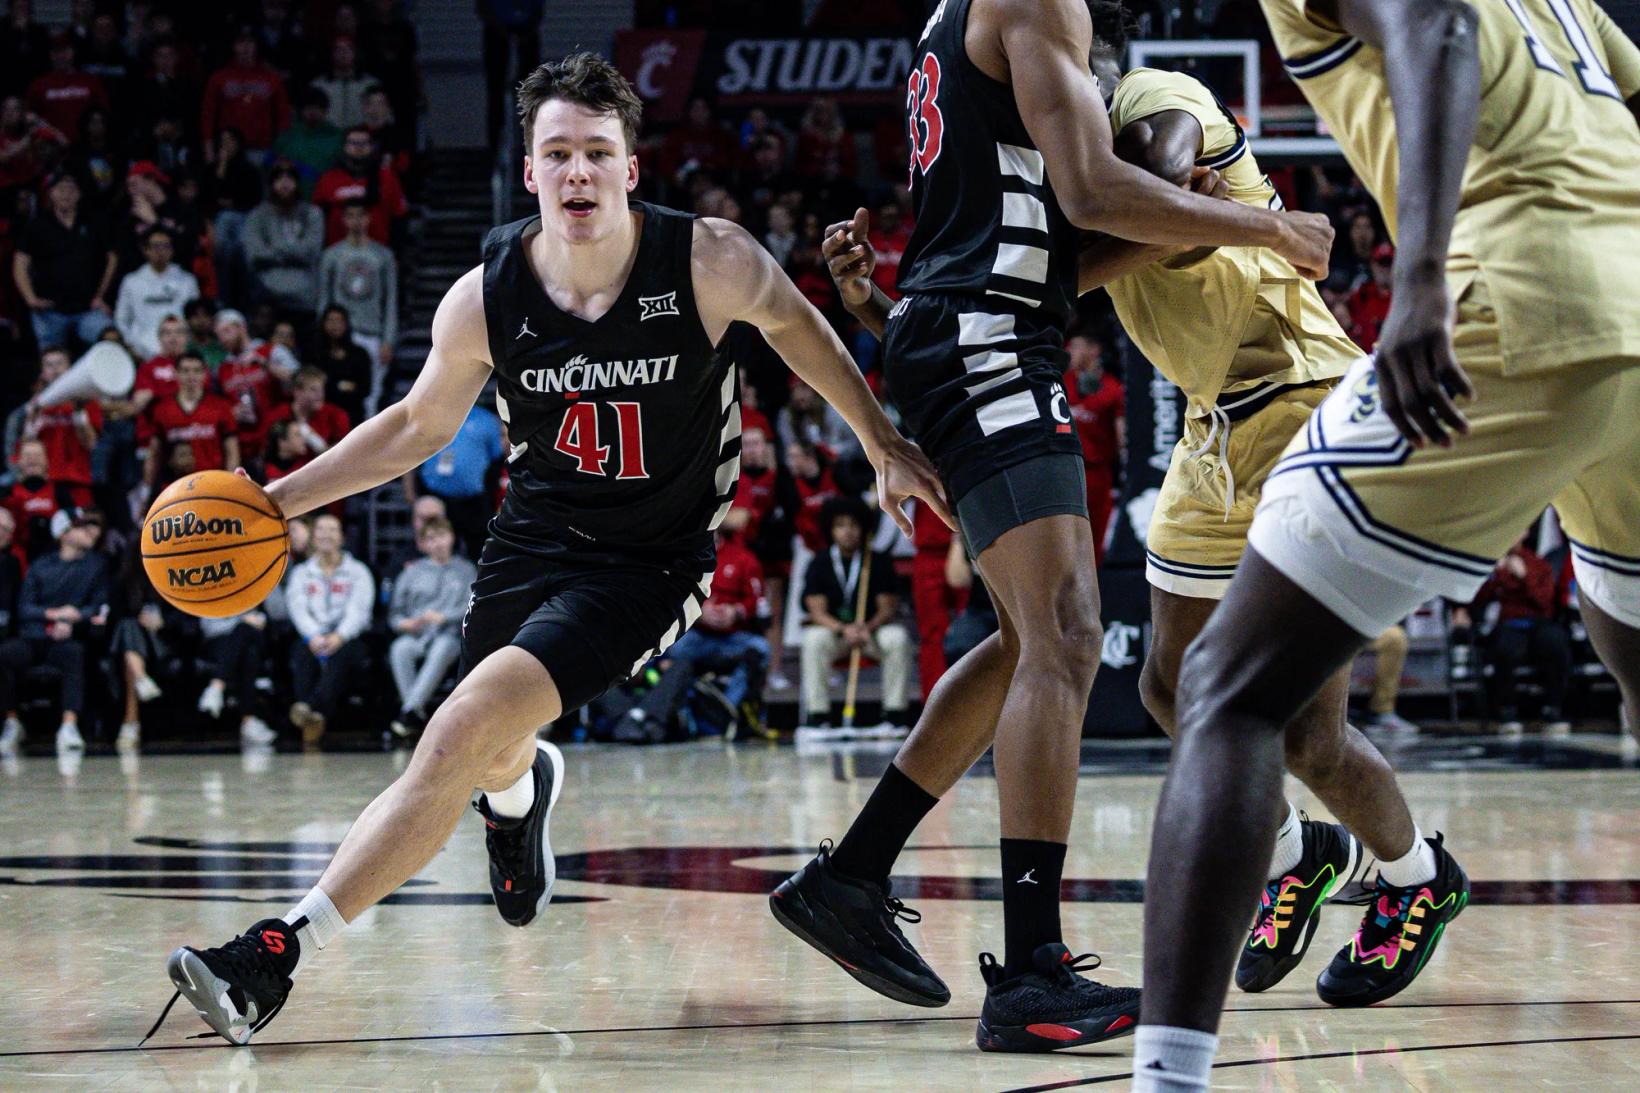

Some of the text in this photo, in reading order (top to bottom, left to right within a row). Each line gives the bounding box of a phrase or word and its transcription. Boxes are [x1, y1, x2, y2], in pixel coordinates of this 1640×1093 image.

[520, 354, 679, 393] CINCINNATI
[554, 401, 650, 480] 41
[151, 511, 243, 544] Wilson
[168, 559, 236, 586] NCAA
